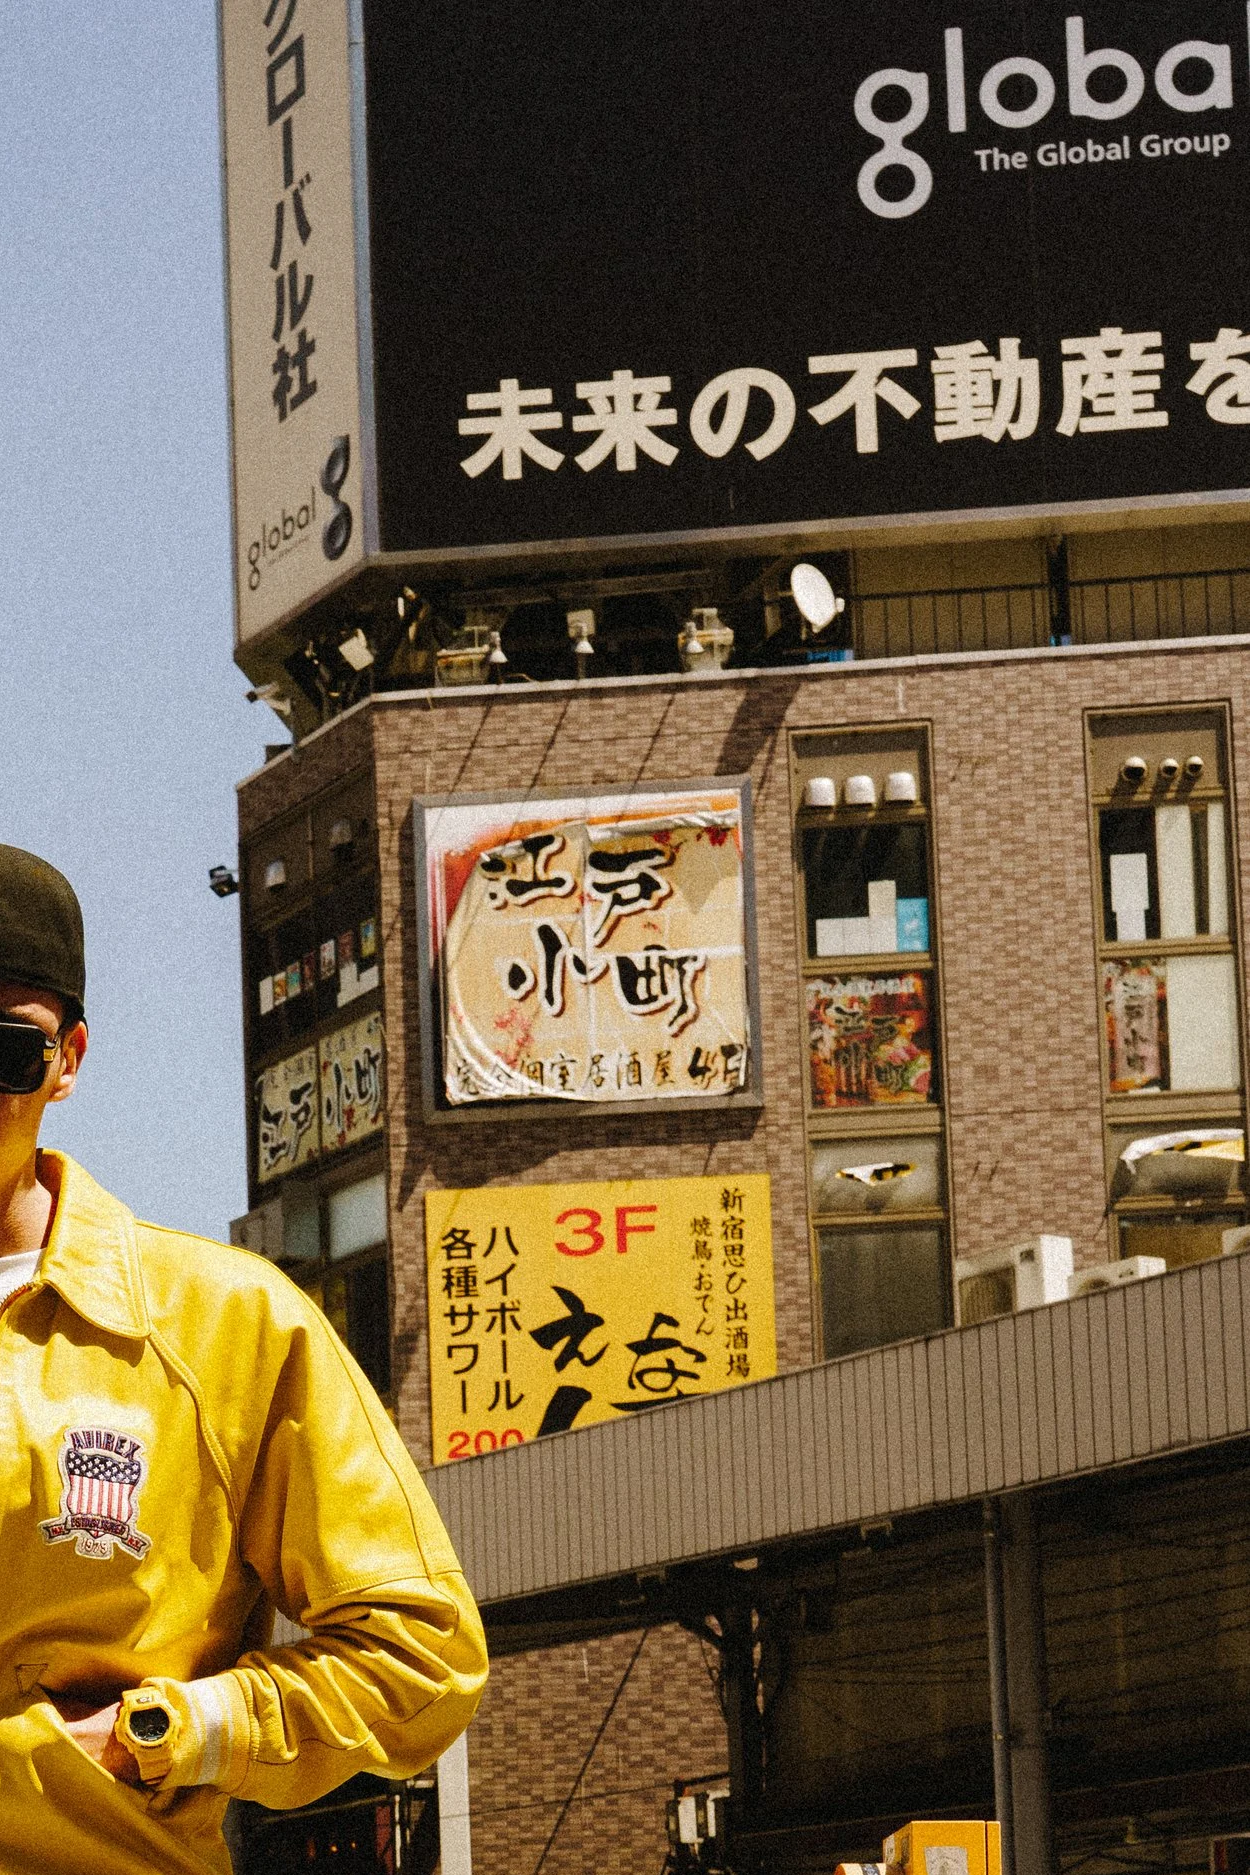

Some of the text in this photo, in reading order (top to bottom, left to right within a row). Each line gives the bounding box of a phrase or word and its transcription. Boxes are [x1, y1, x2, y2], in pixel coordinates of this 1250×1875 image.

[853, 0, 1250, 218] globa
[974, 131, 1232, 172] The Global Group
[457, 326, 1250, 481] 未来の不動産を
[248, 485, 317, 592] global
[479, 832, 672, 938] 江戸
[506, 920, 702, 1028] 小町
[553, 1204, 659, 1258] 3F
[718, 1187, 751, 1379] 新宿思ひ出酒場
[440, 1226, 481, 1415] 各種サワー
[482, 1225, 525, 1413] ハイボール
[69, 1429, 142, 1462] AVIREX
